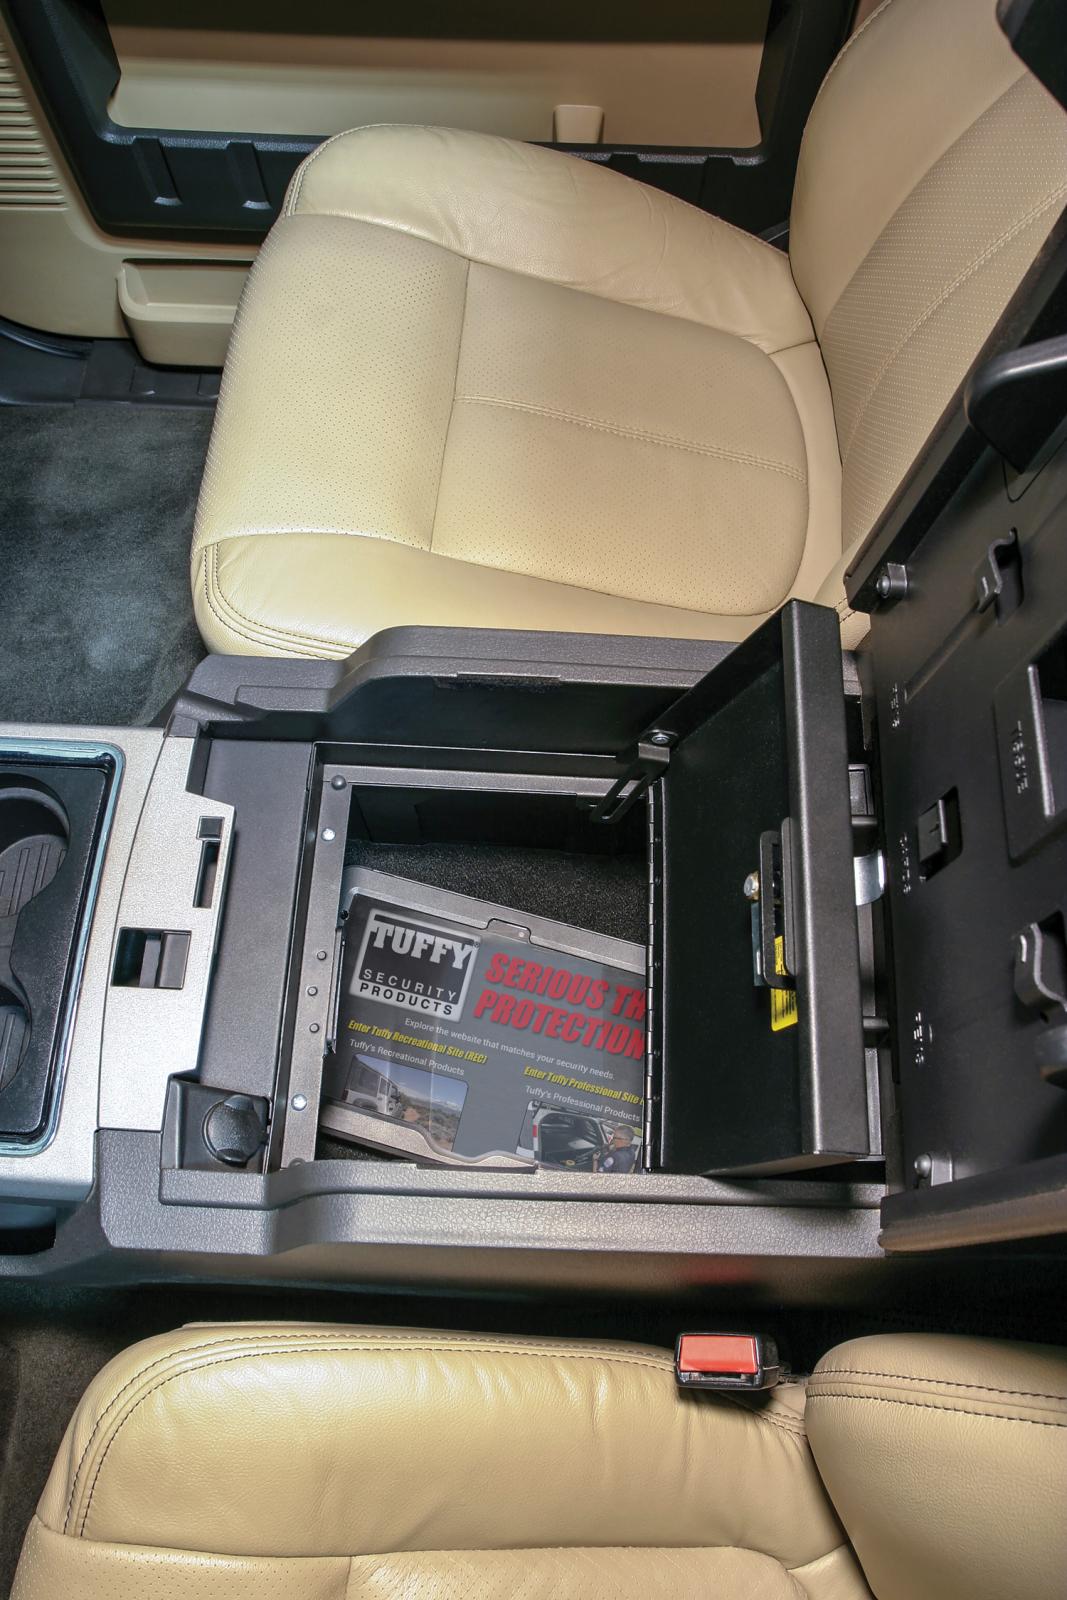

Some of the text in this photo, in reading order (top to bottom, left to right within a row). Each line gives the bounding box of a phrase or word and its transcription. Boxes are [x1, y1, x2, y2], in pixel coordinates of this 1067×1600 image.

[370, 921, 475, 969] TUFFY
[360, 982, 453, 1015] PRODUCTS
[363, 968, 457, 1001] SECURITY
[485, 952, 646, 1022] SERIOUS TH
[348, 1020, 487, 1064] Enter Tuffy Recreational Site (REC)
[473, 989, 645, 1060] PROTECTION
[350, 1039, 465, 1076] Tuffy's Recreational Products
[405, 1018, 615, 1081] Explore the website that matches your security needs.
[524, 1066, 545, 1079] Enter
[547, 1071, 568, 1086] Tuffy
[568, 1077, 622, 1099] Professional
[622, 1091, 639, 1105] Site
[526, 1085, 641, 1123] Tuffy's Professional Products
